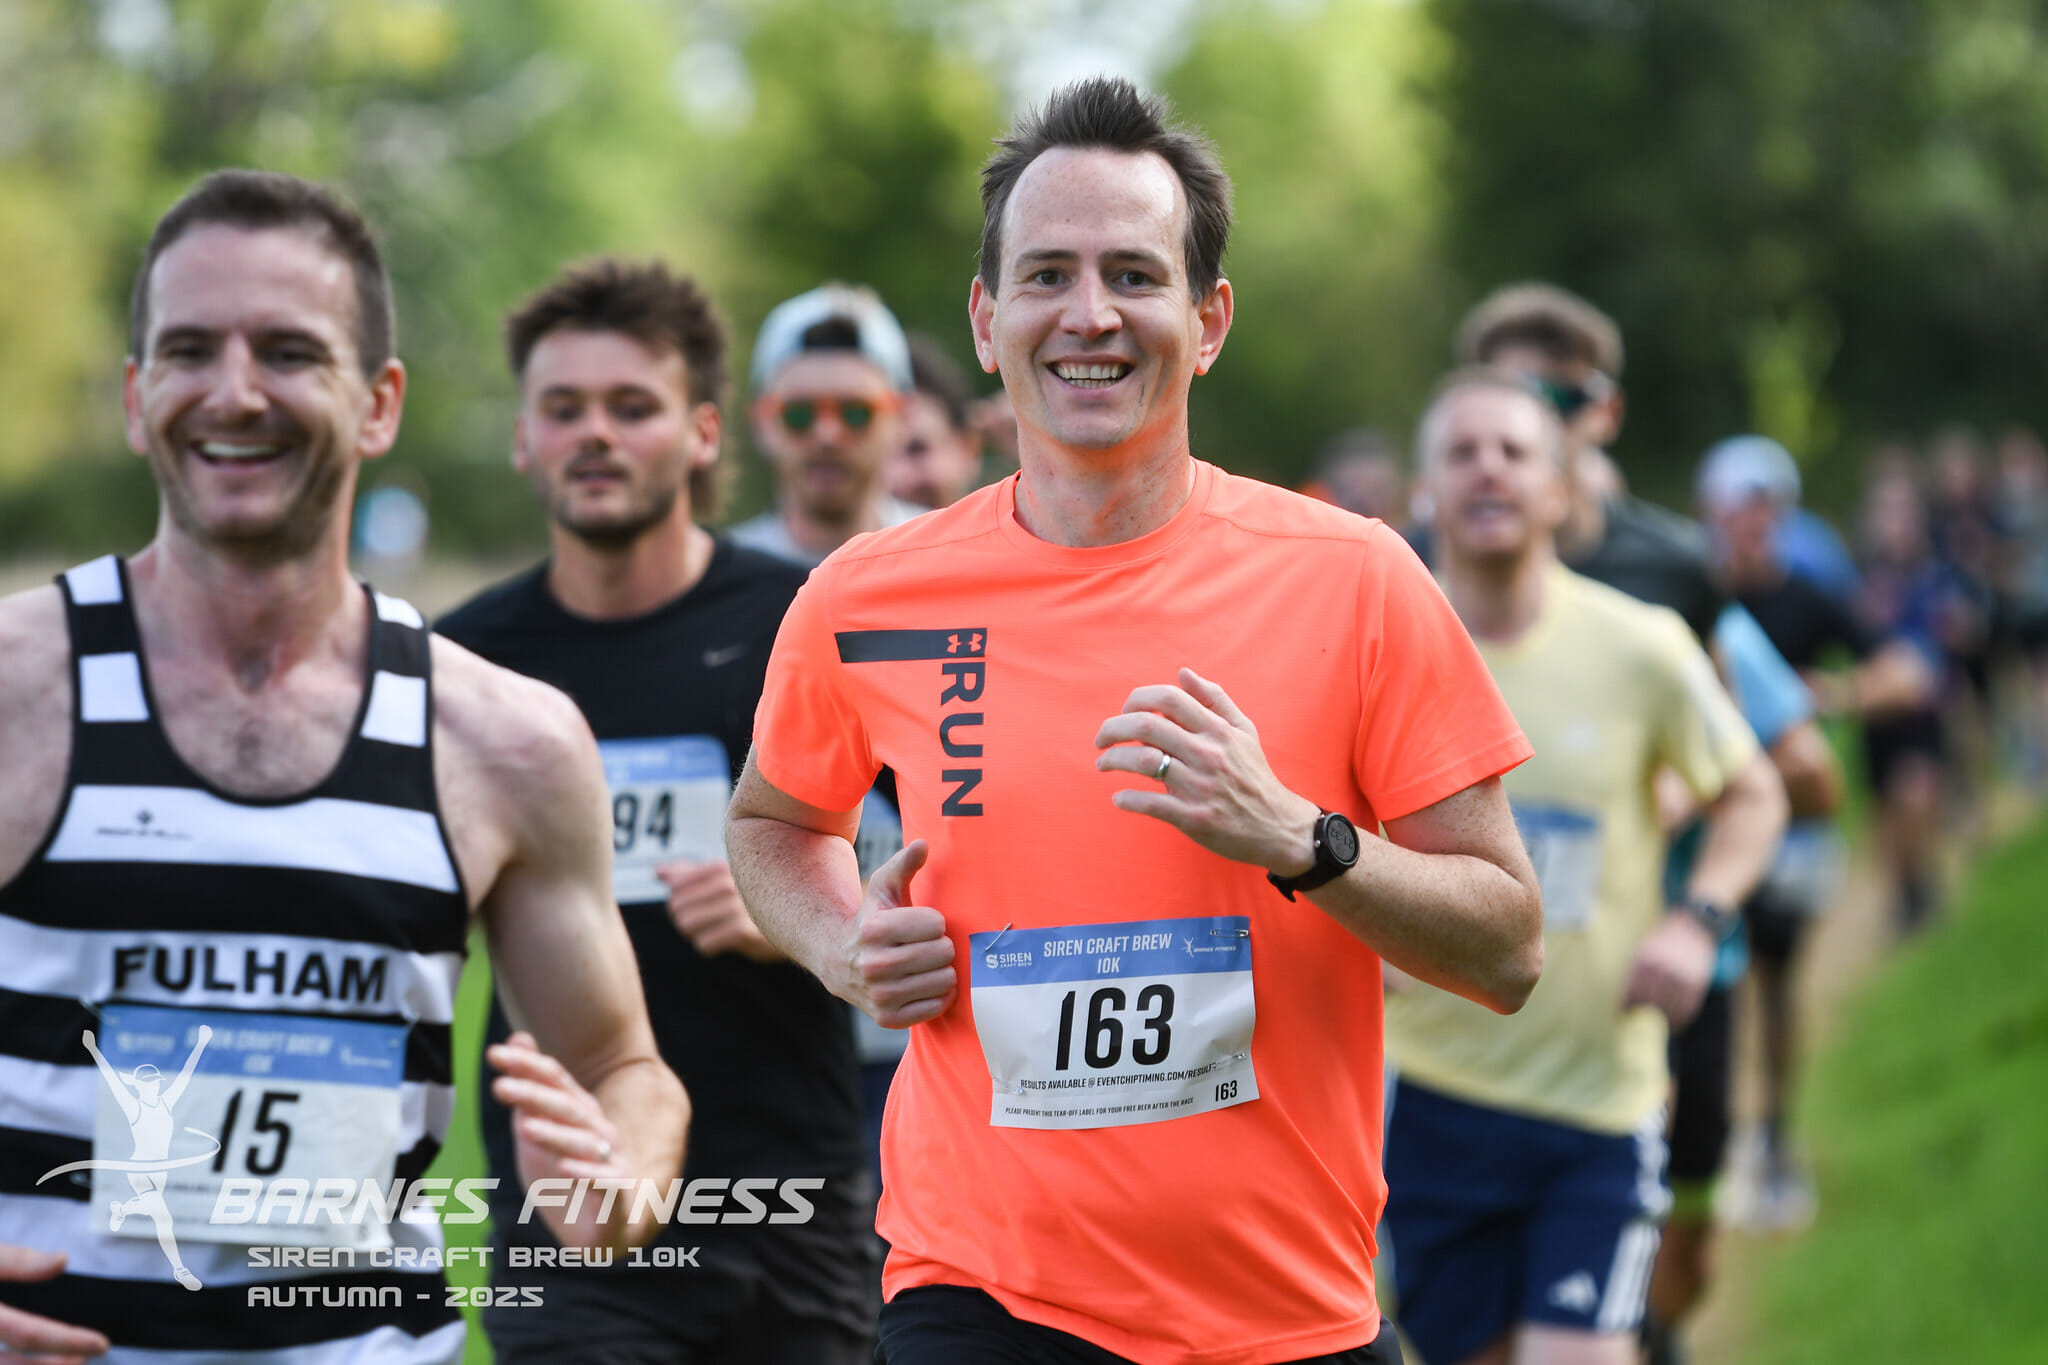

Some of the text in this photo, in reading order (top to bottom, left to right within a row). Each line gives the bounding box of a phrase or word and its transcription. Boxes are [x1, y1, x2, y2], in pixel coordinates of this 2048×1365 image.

[939, 661, 985, 817] RUN
[613, 790, 675, 851] 94
[1043, 933, 1173, 957] SIREN CRAFT BREW
[999, 952, 1032, 963] SIREN
[1097, 957, 1120, 974] 10K
[112, 946, 388, 1004] FULHAM
[1055, 984, 1175, 1071] 163
[1020, 1079, 1046, 1090] RESULTS
[1047, 1078, 1086, 1090] AVAILABLE
[1215, 1080, 1238, 1102] 163
[1079, 1108, 1095, 1116] LABEL
[1096, 1107, 1107, 1115] FOR
[1107, 1106, 1122, 1114] YOUR
[1123, 1104, 1136, 1112] FREE
[1137, 1103, 1151, 1111] BEER
[1152, 1102, 1168, 1110] AFTER
[211, 1087, 301, 1177] 15
